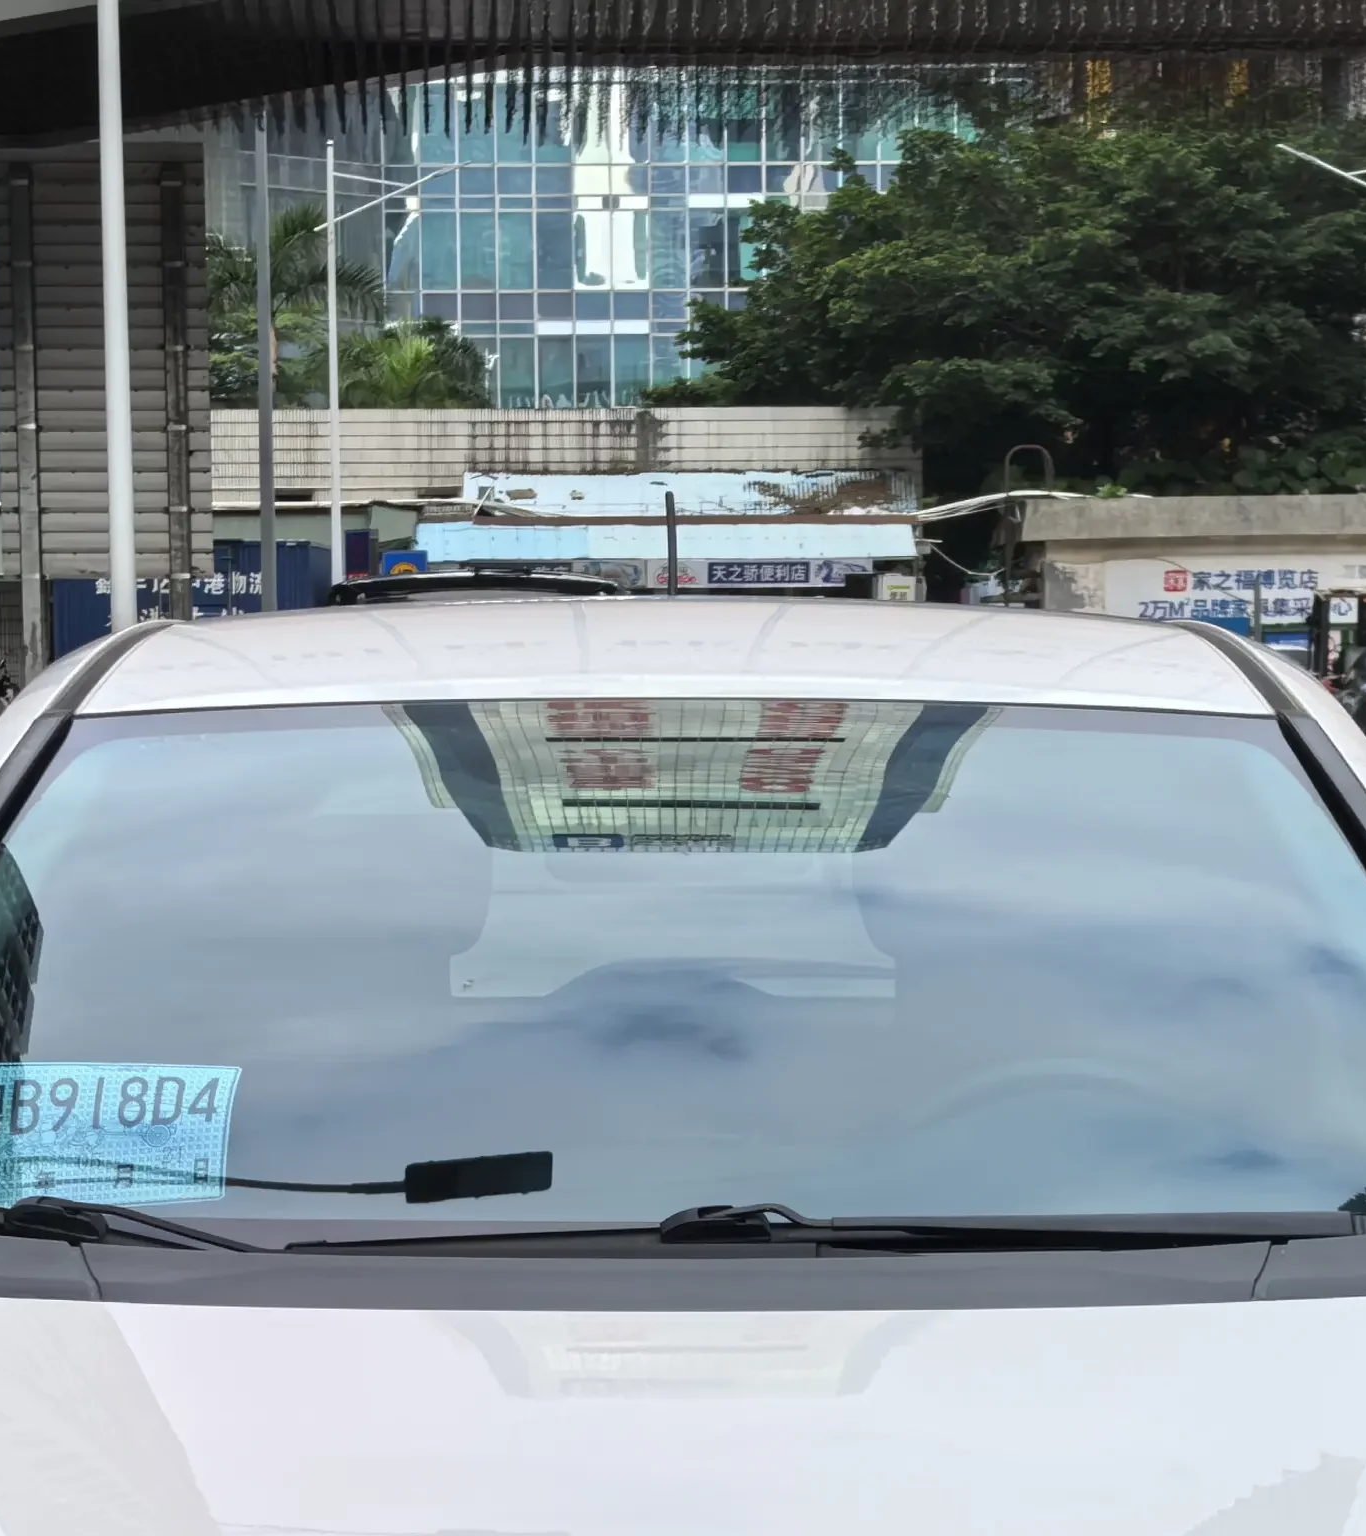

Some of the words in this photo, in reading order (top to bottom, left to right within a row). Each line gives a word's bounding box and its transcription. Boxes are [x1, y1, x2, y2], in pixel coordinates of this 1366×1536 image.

[711, 563, 807, 583] 天之骄便利店
